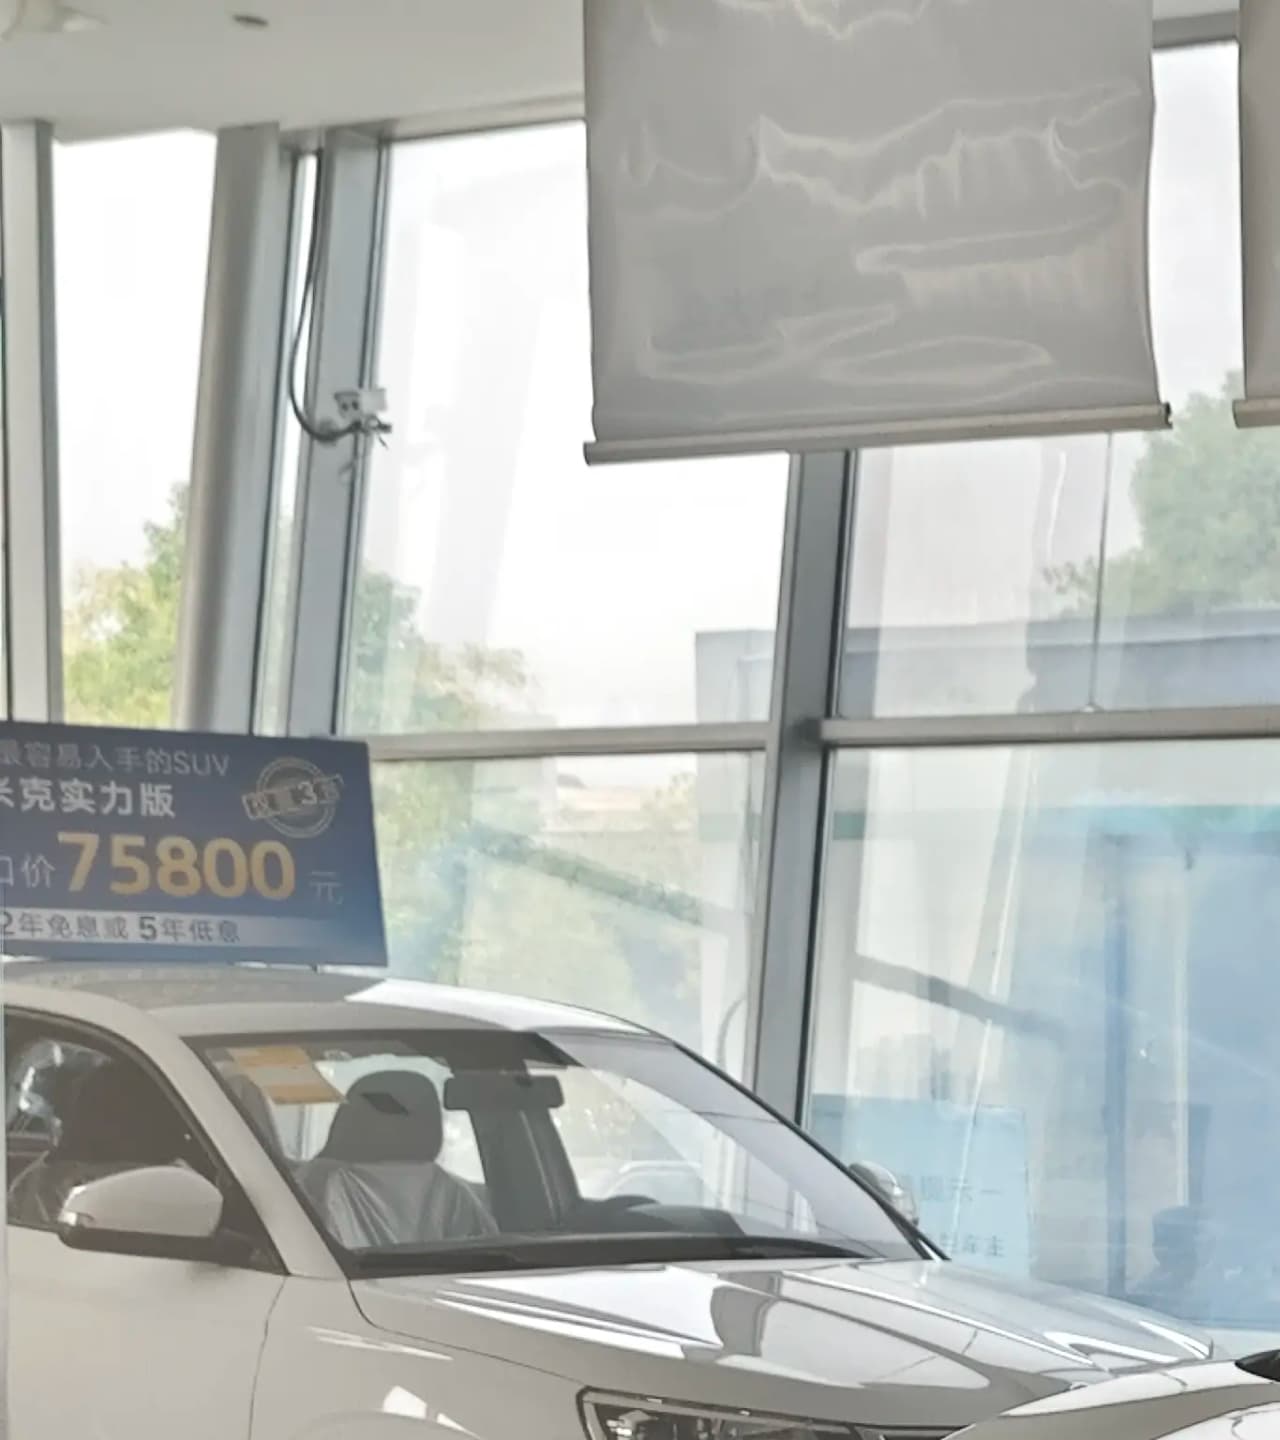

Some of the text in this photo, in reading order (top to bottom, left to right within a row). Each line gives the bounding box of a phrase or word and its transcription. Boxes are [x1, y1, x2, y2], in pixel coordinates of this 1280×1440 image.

[57, 831, 295, 900] 75800
[309, 871, 343, 904] 元
[139, 916, 240, 943] 5年低息
